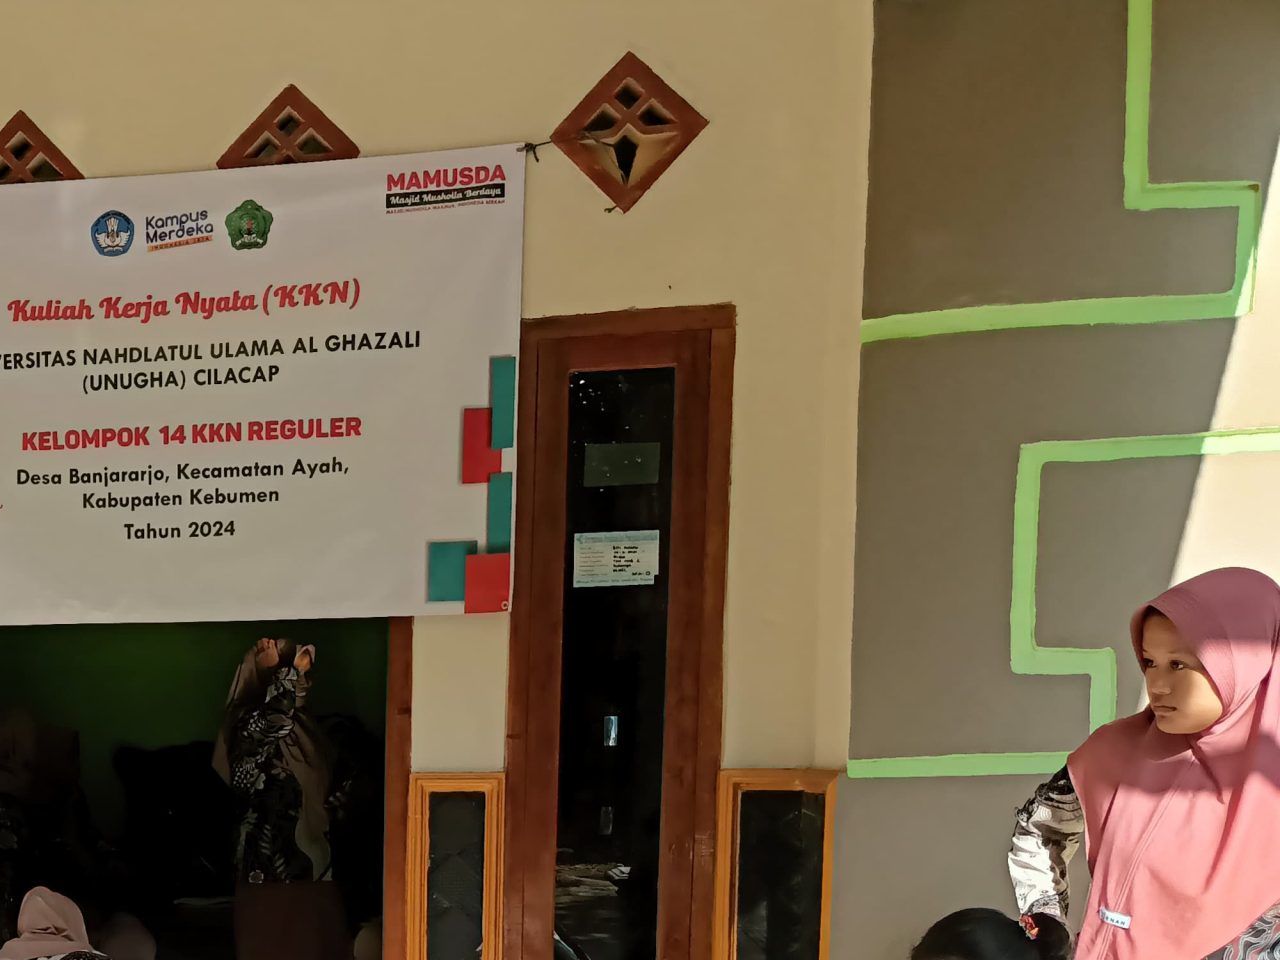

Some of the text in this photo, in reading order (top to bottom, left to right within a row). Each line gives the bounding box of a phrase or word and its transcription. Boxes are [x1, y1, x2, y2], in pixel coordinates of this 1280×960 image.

[386, 164, 506, 191] MAMUSDA
[389, 195, 420, 206] Masjid
[464, 187, 501, 198] Berdaya
[145, 210, 208, 231] Kampus
[145, 222, 214, 244] Merdeka
[7, 278, 361, 324] Kuliah Kerja Nyata (KKN)
[82, 344, 203, 366] NAHDLATUL
[209, 338, 285, 359] ULAMA
[292, 335, 319, 355] AL
[325, 330, 421, 352] GHAZALI
[82, 364, 280, 395] (UNUGHA) CILACAP
[22, 417, 362, 451] KELOMPOK 14 KKN REGULER
[17, 456, 349, 487] Desa Banjararjo, Kecamatan Ayah,
[82, 487, 280, 512] Kabupaten Kebumen
[124, 520, 236, 539] Tahun 2024
